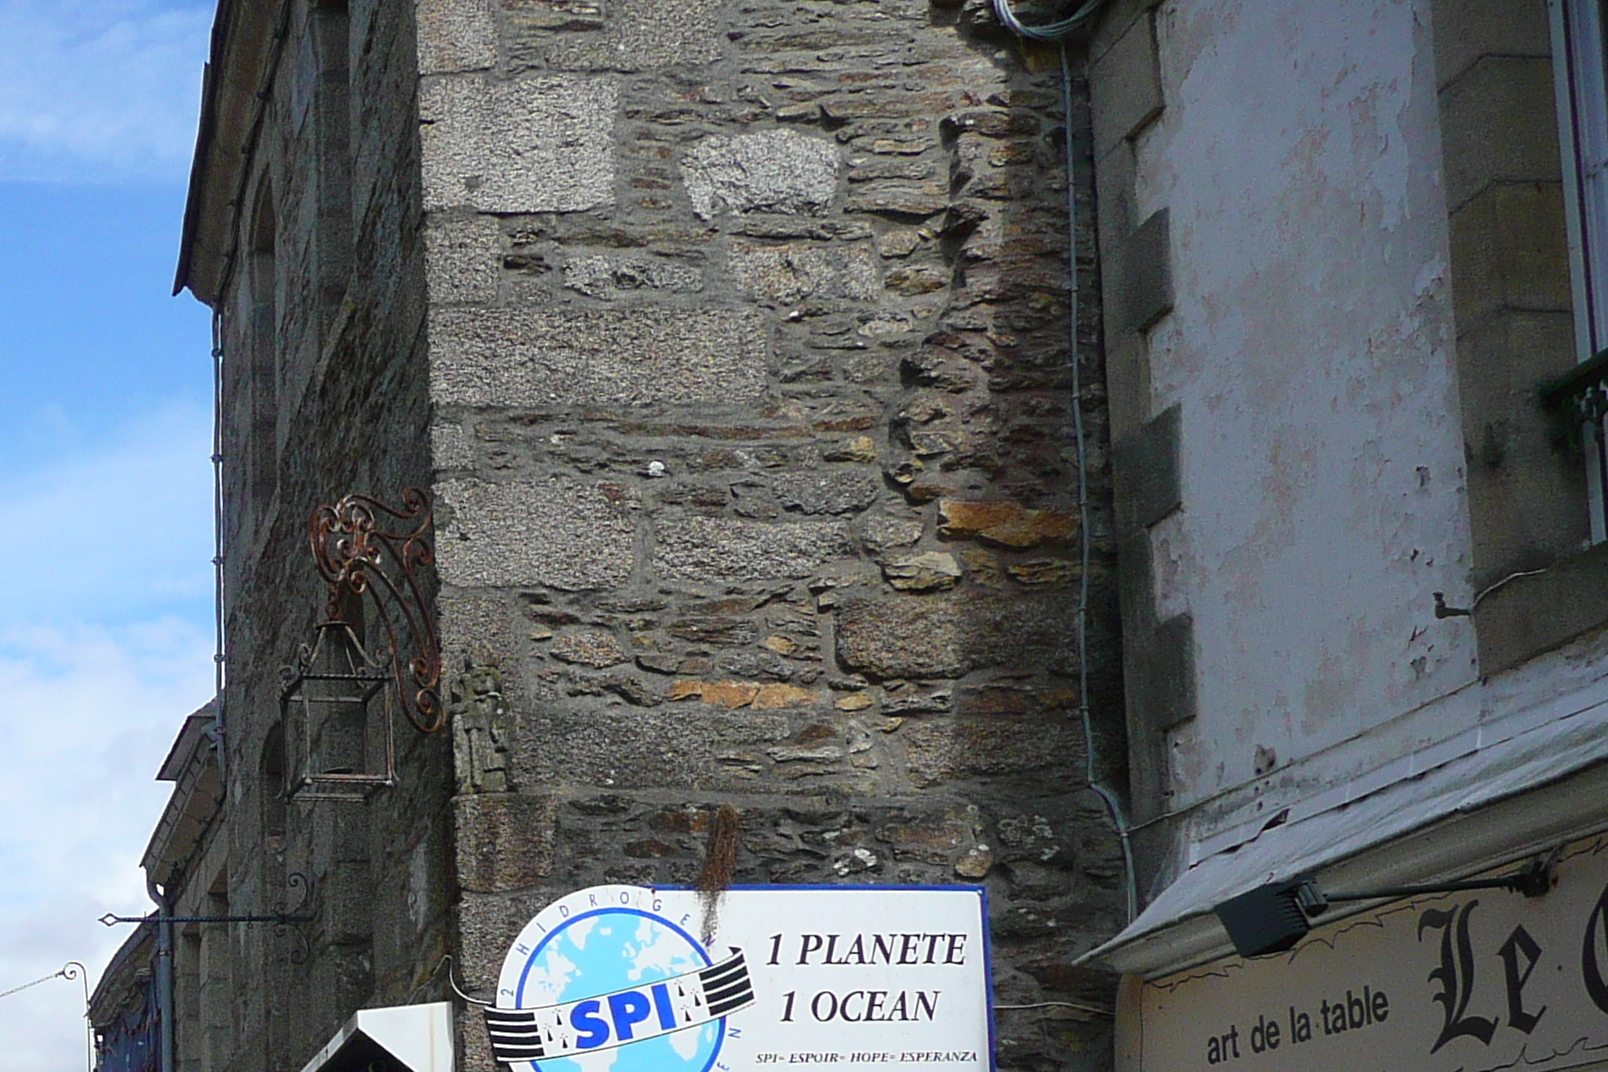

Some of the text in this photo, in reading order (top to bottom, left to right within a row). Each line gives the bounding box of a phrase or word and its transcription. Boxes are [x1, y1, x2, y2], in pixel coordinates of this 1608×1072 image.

[766, 932, 968, 966] 1 PLANETE
[1417, 899, 1547, 1055] Le
[570, 983, 677, 1049] SPI
[780, 990, 941, 1023] 1 OCEAN
[1207, 985, 1389, 1065] art de la table
[899, 1050, 978, 1063] ESPERANZA
